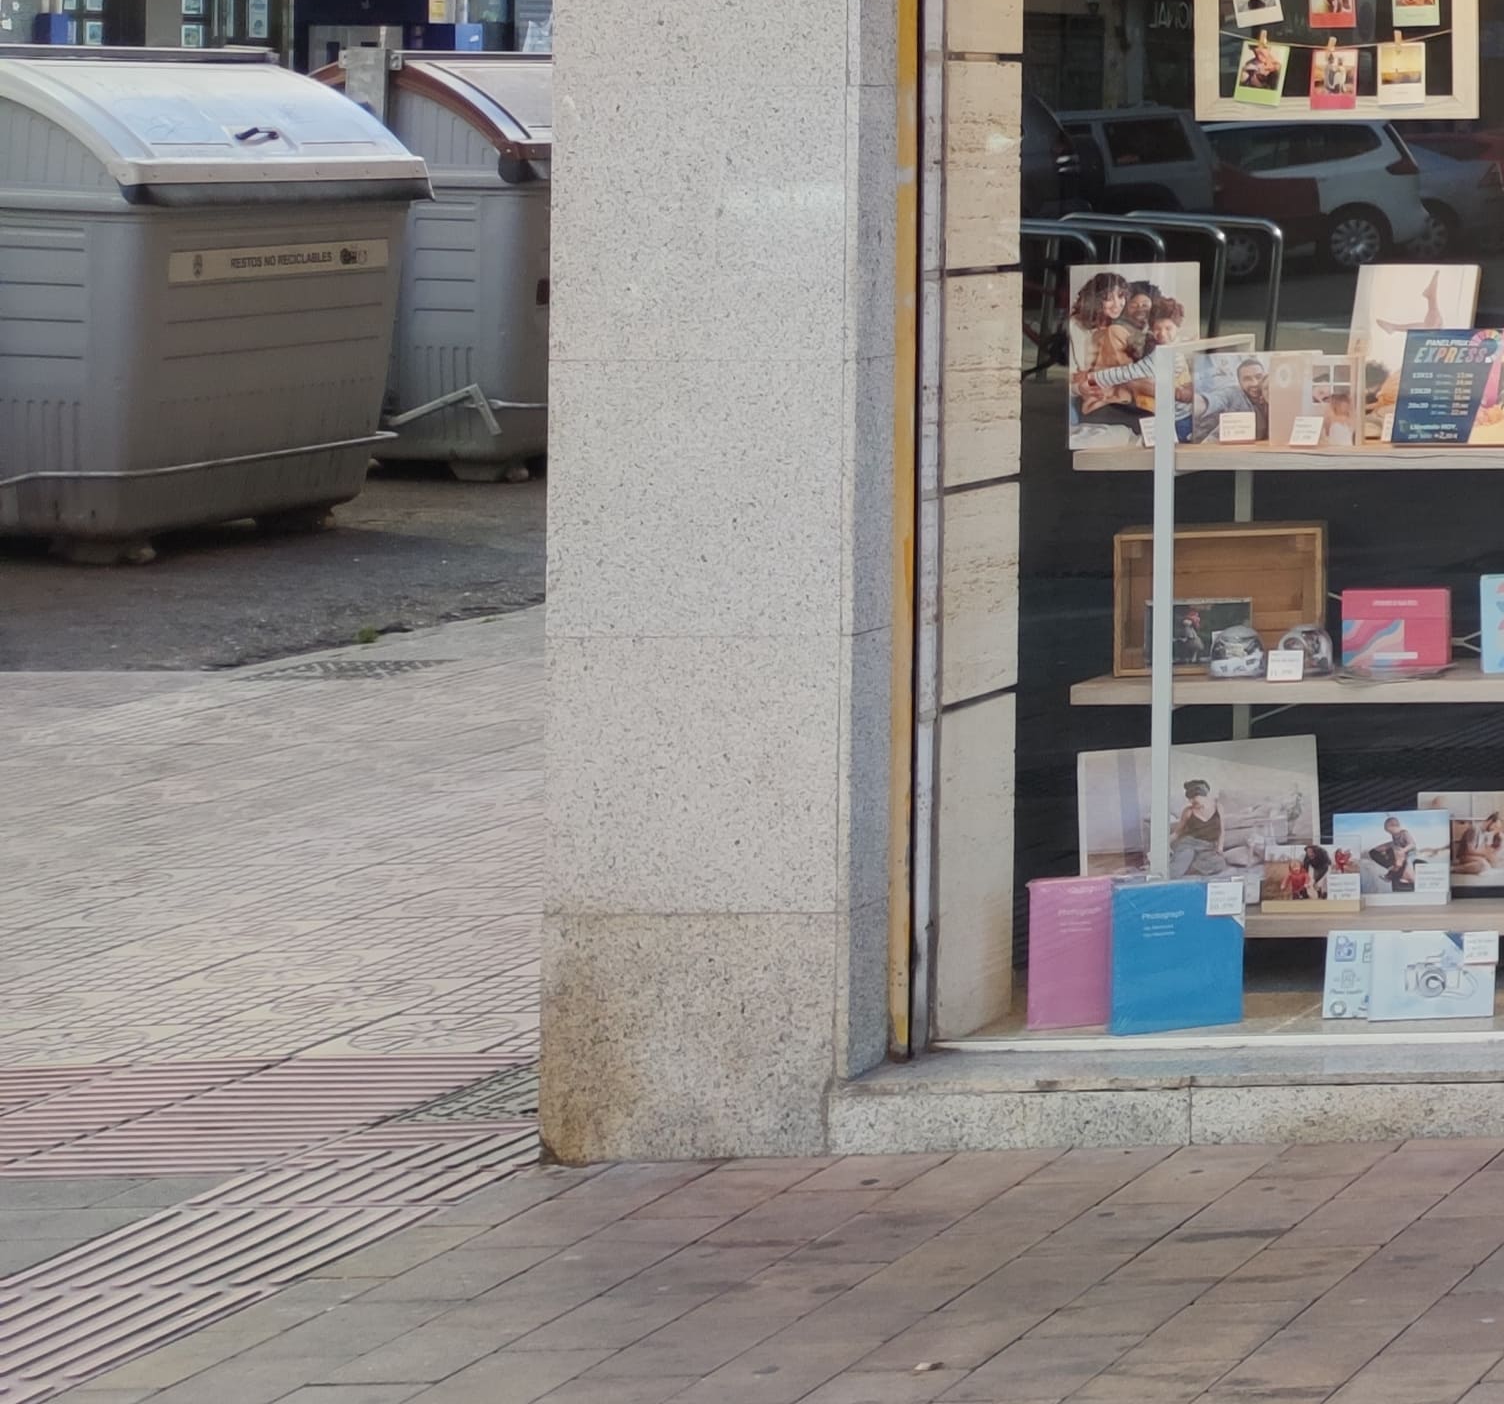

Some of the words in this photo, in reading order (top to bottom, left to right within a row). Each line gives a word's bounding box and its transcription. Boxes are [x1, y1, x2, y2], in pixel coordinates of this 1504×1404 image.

[230, 256, 263, 269] RESTOS
[263, 255, 275, 267] NO
[277, 251, 332, 266] RECICLABLES
[1413, 347, 1488, 364] EXPRESS
